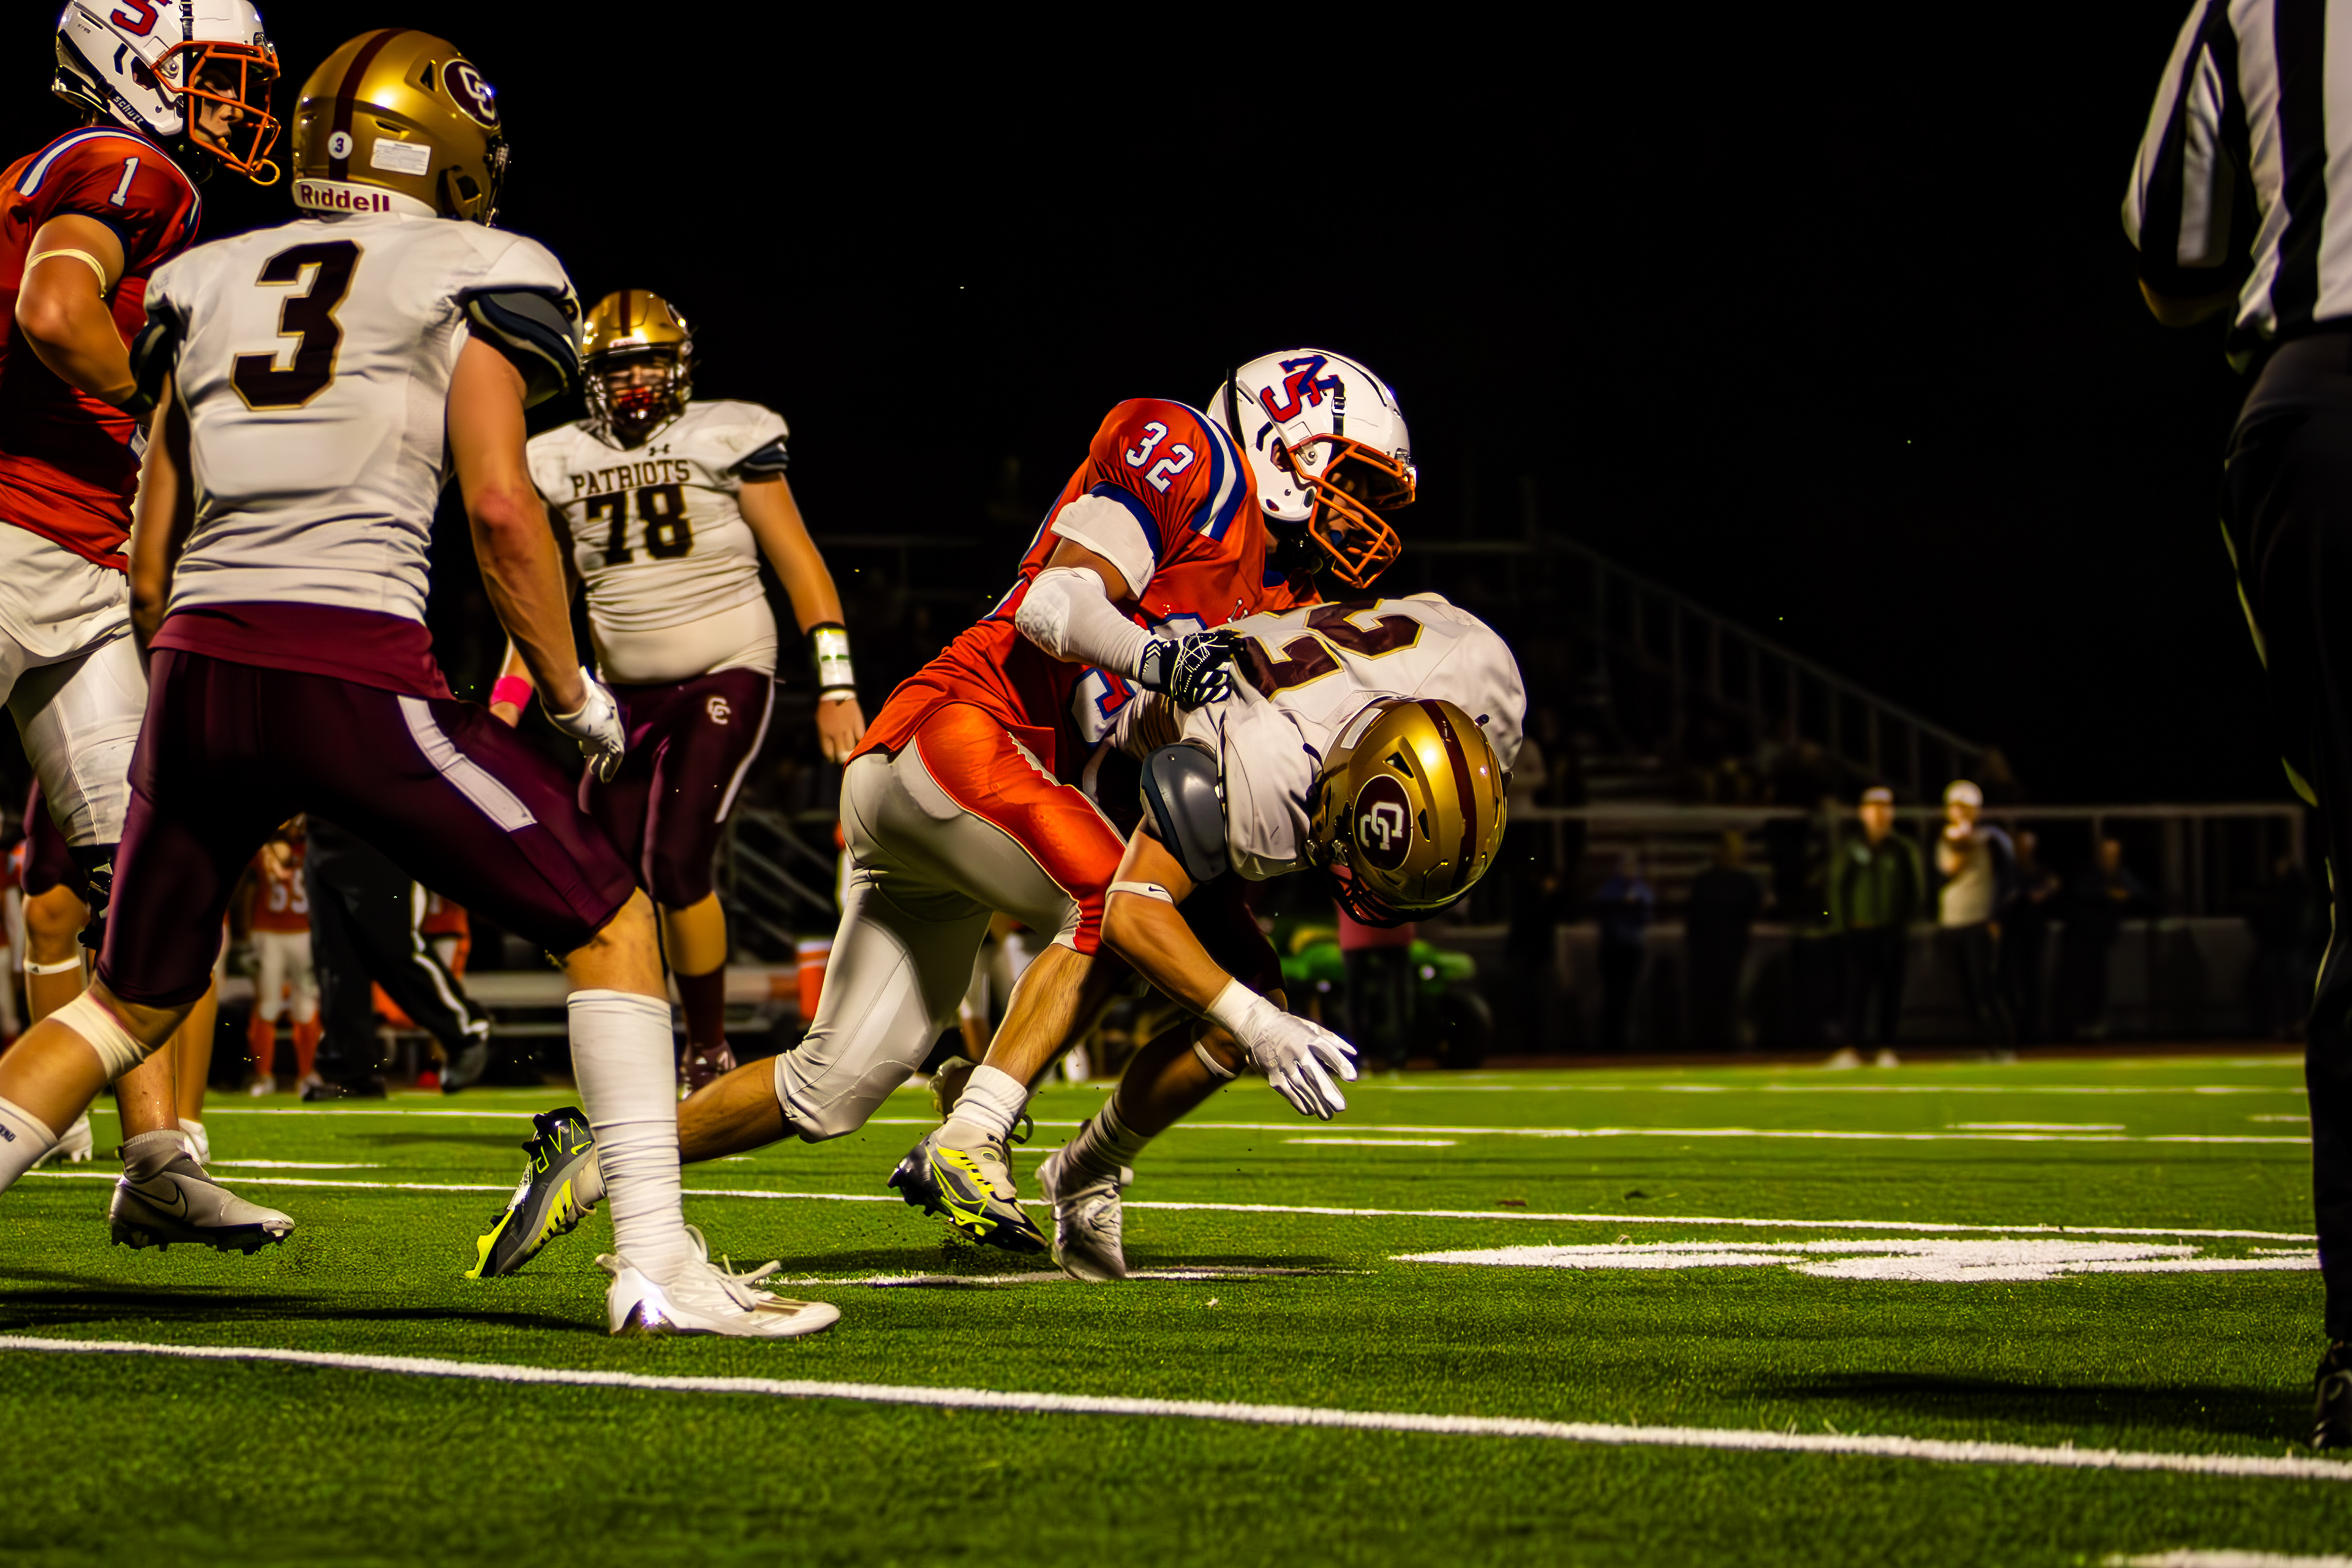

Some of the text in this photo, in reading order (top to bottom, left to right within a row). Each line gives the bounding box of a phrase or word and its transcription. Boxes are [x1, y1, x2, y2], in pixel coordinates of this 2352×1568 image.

[113, 96, 144, 125] schutt
[334, 137, 345, 153] 3
[108, 157, 140, 208] 1
[300, 184, 390, 213] Riddell
[230, 238, 364, 412] 3
[571, 459, 690, 497] PATRIOTS
[1125, 420, 1196, 495] 32
[585, 483, 695, 568] 78
